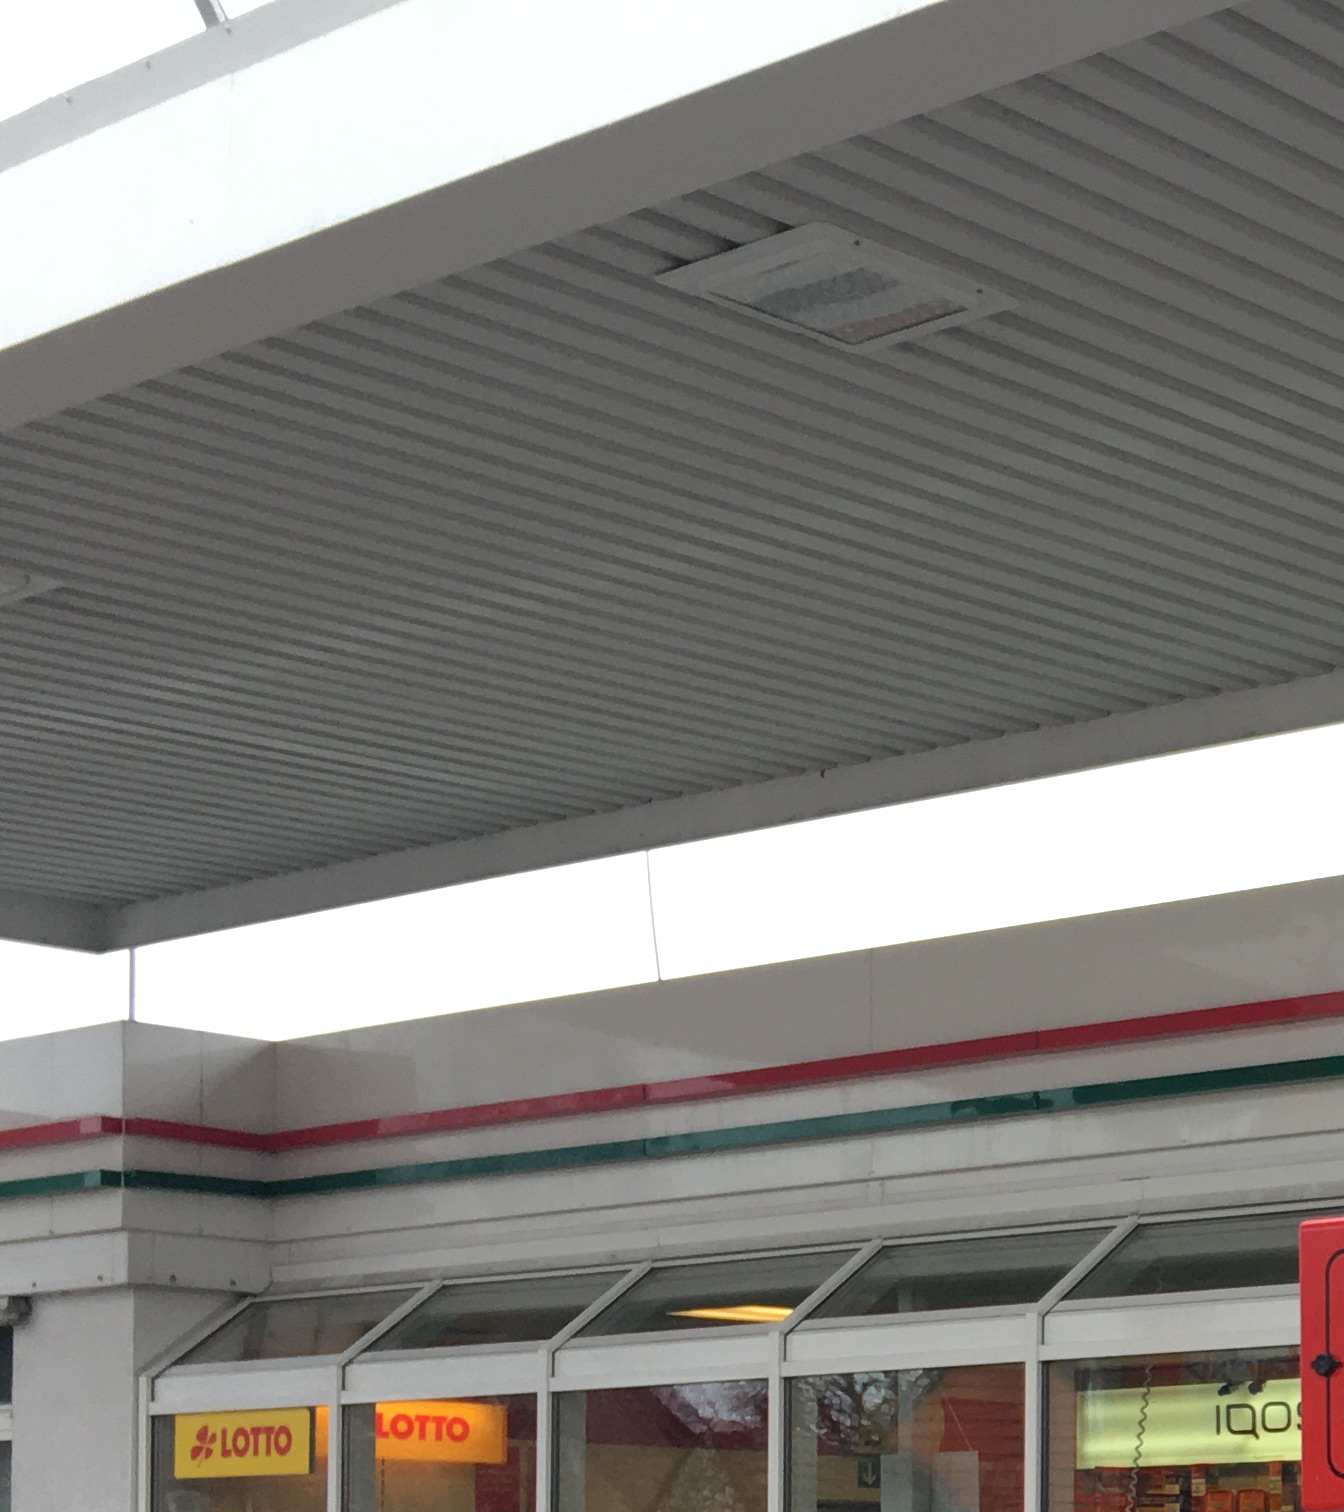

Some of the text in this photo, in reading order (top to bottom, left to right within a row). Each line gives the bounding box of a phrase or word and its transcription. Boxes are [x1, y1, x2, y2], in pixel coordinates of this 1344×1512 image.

[375, 1413, 470, 1443] LOTTO
[1216, 1401, 1302, 1440] IQO
[221, 1425, 293, 1457] LOTTO
